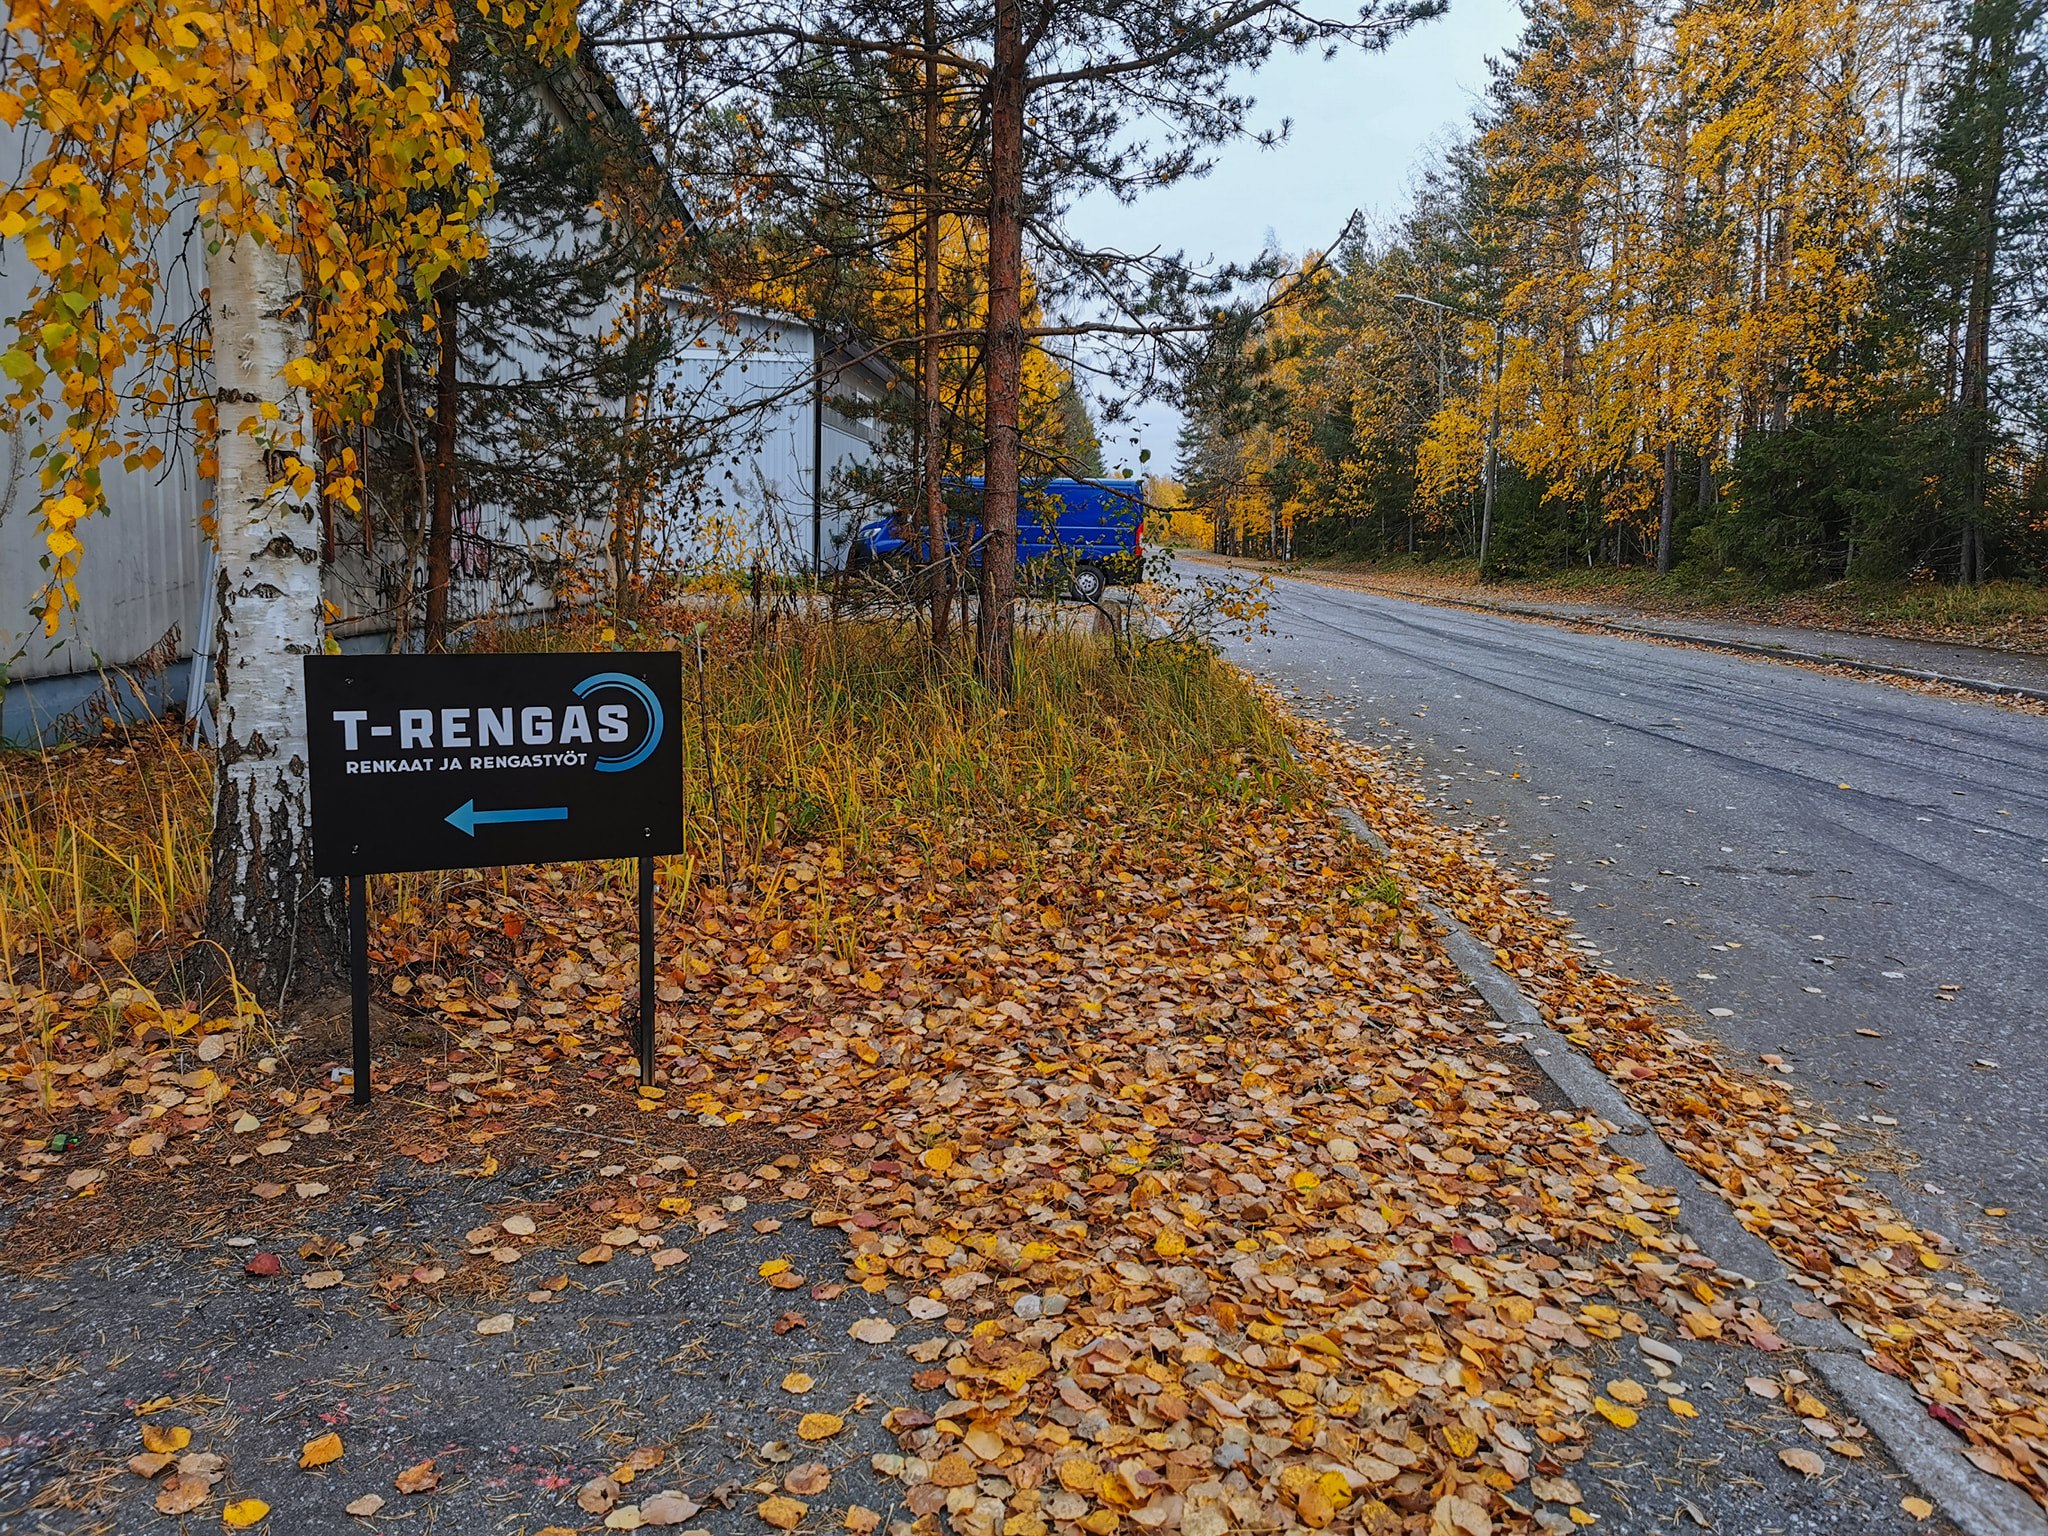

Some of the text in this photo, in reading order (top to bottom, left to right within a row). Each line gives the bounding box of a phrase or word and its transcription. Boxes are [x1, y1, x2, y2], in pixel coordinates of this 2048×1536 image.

[332, 704, 629, 751] T-RENGAS
[346, 750, 588, 774] RENKAAT JA RENGASTYÖT
